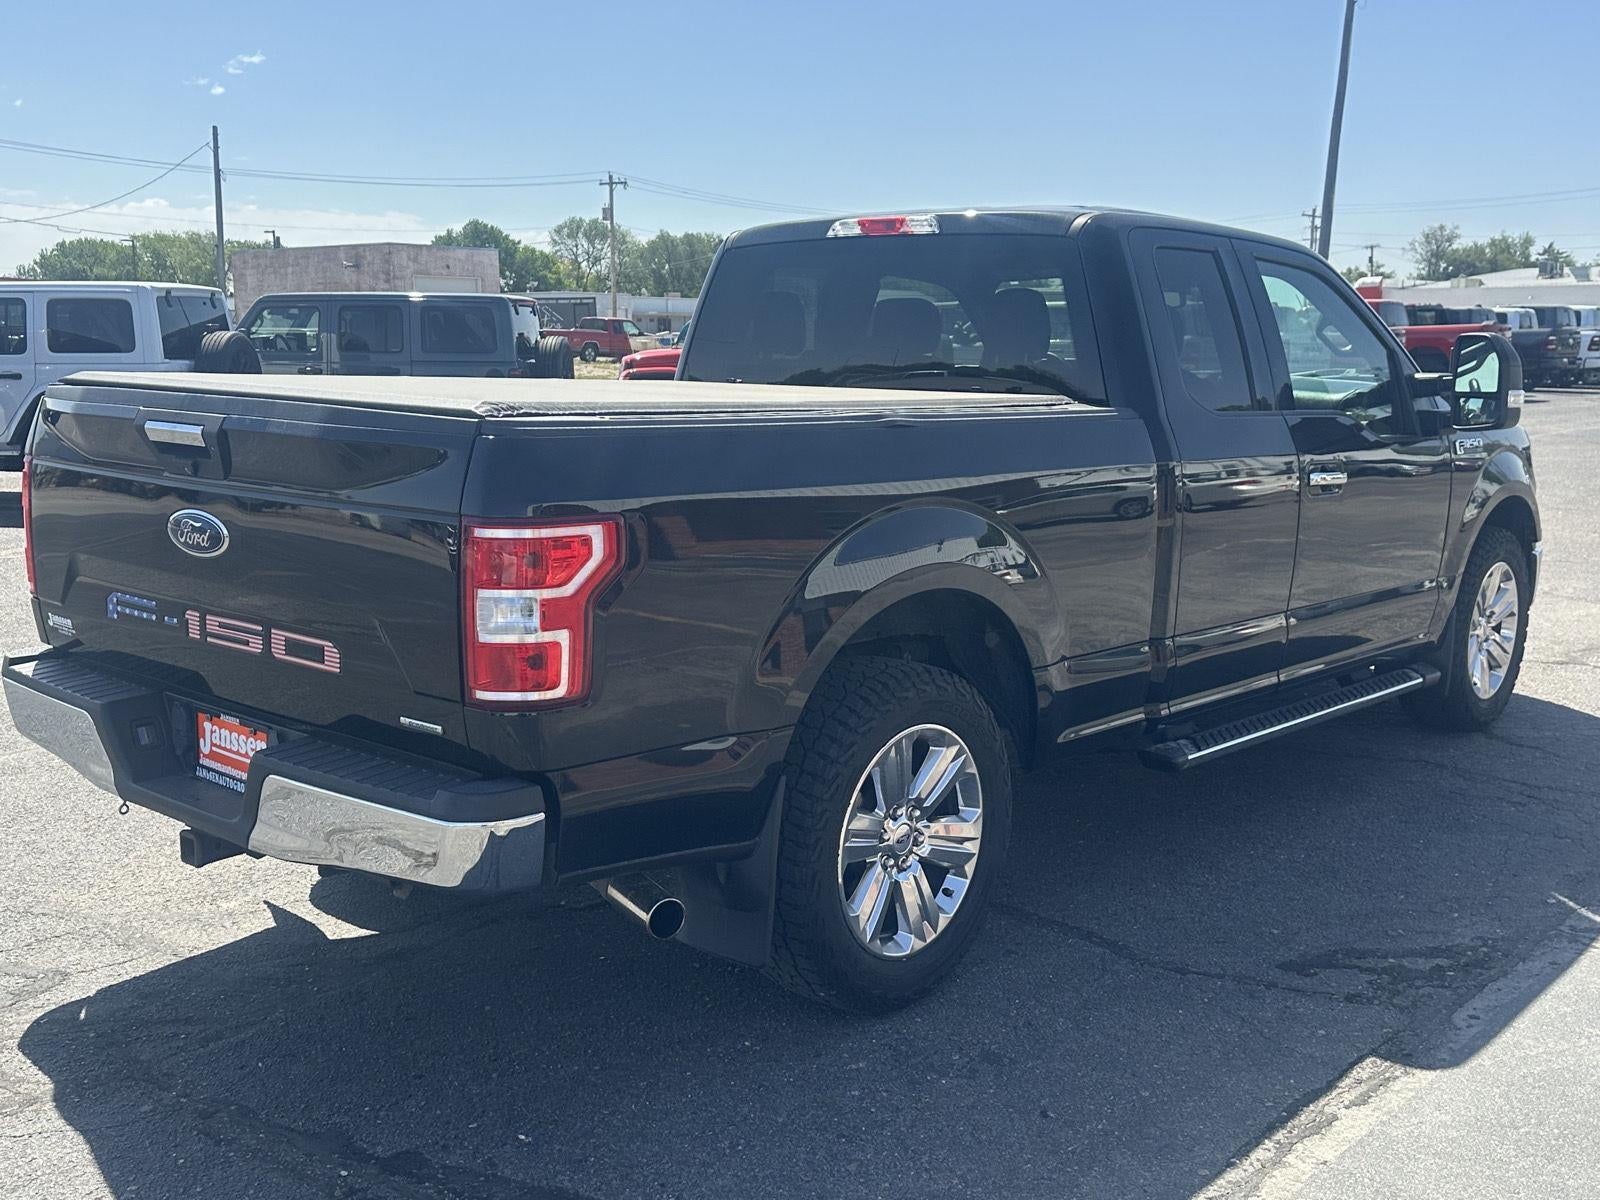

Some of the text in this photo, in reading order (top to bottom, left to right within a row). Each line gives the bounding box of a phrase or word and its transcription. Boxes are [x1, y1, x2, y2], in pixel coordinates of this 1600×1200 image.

[178, 518, 211, 547] Ford
[106, 591, 341, 673] F-150
[200, 721, 268, 757] Janssen
